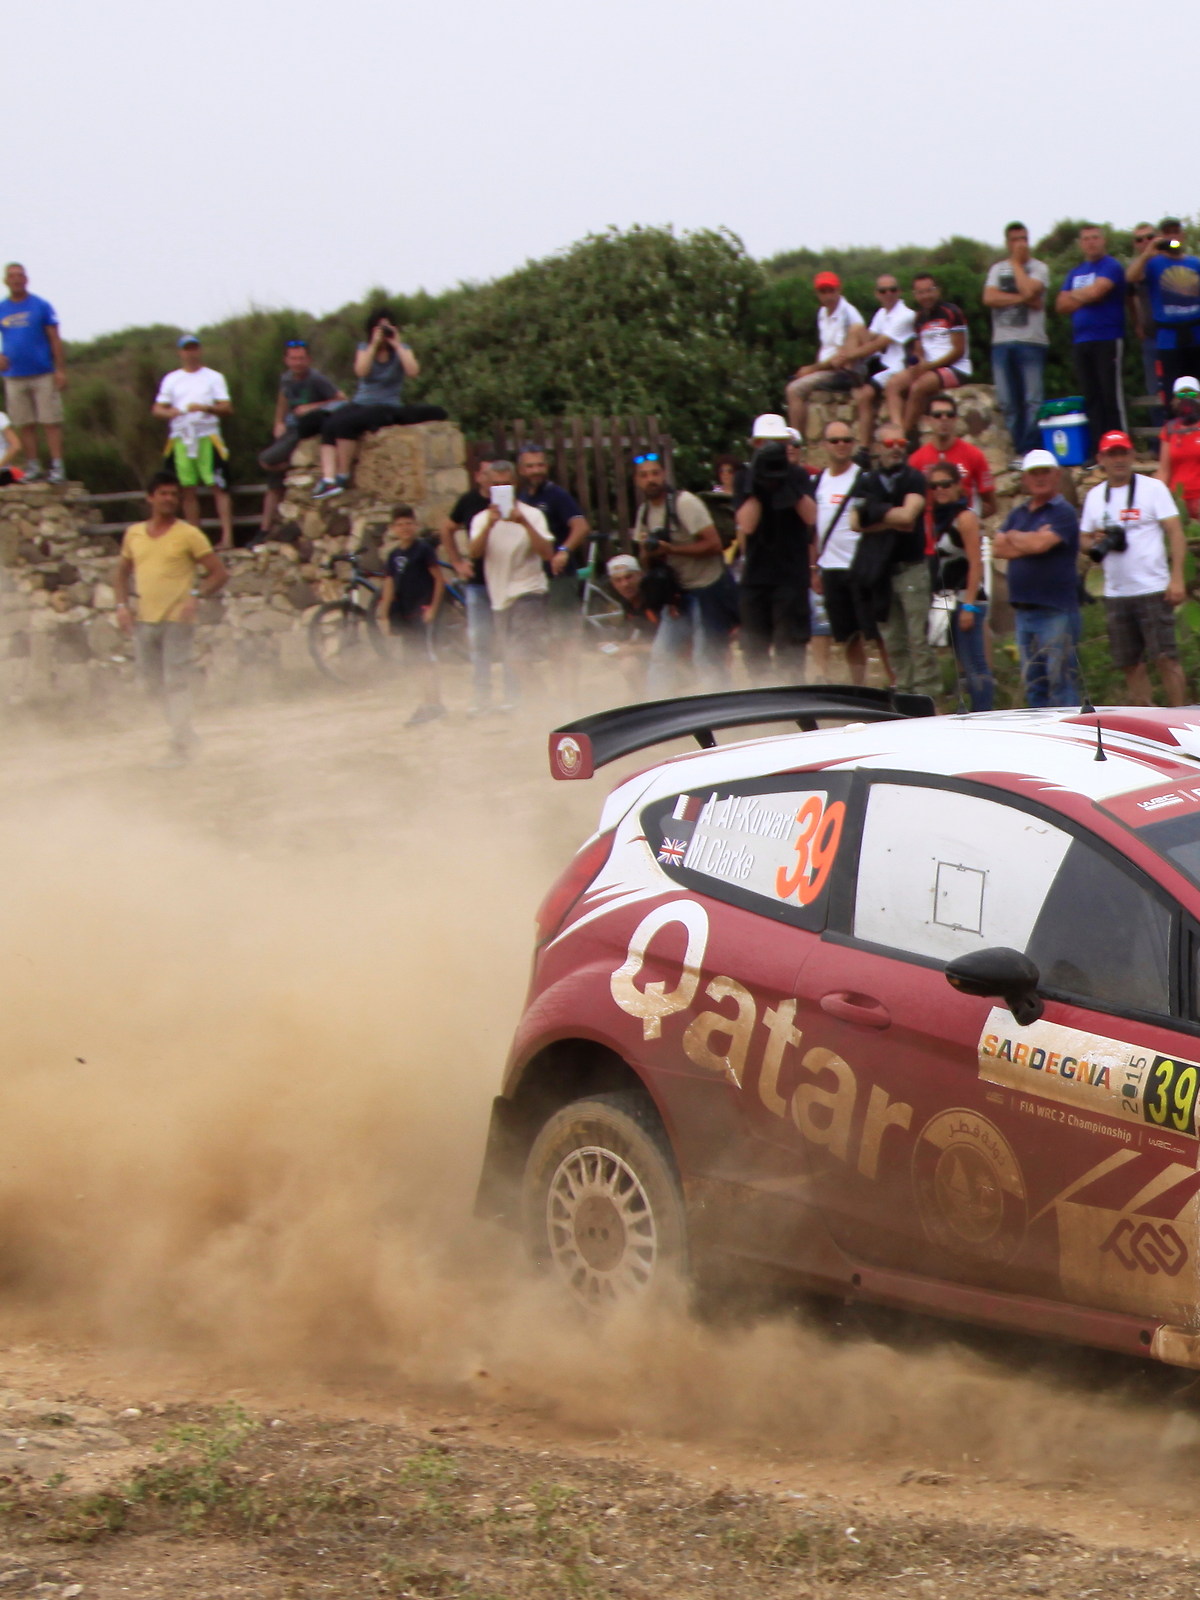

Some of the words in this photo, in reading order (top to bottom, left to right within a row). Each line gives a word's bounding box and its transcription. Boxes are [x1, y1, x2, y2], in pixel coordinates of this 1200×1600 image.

[700, 791, 719, 825] A
[717, 794, 800, 842] Al-Kuwari
[683, 833, 704, 868] M
[704, 838, 755, 880] Clarke
[776, 796, 847, 905] 39
[610, 898, 914, 1181] Qatar
[982, 1034, 1111, 1090] SARDEGNA
[1020, 1100, 1035, 1114] FIA
[1036, 1104, 1058, 1122] WRC
[1058, 1111, 1066, 1122] 2
[1067, 1114, 1133, 1143] Championship
[1148, 1060, 1198, 1131] 39
